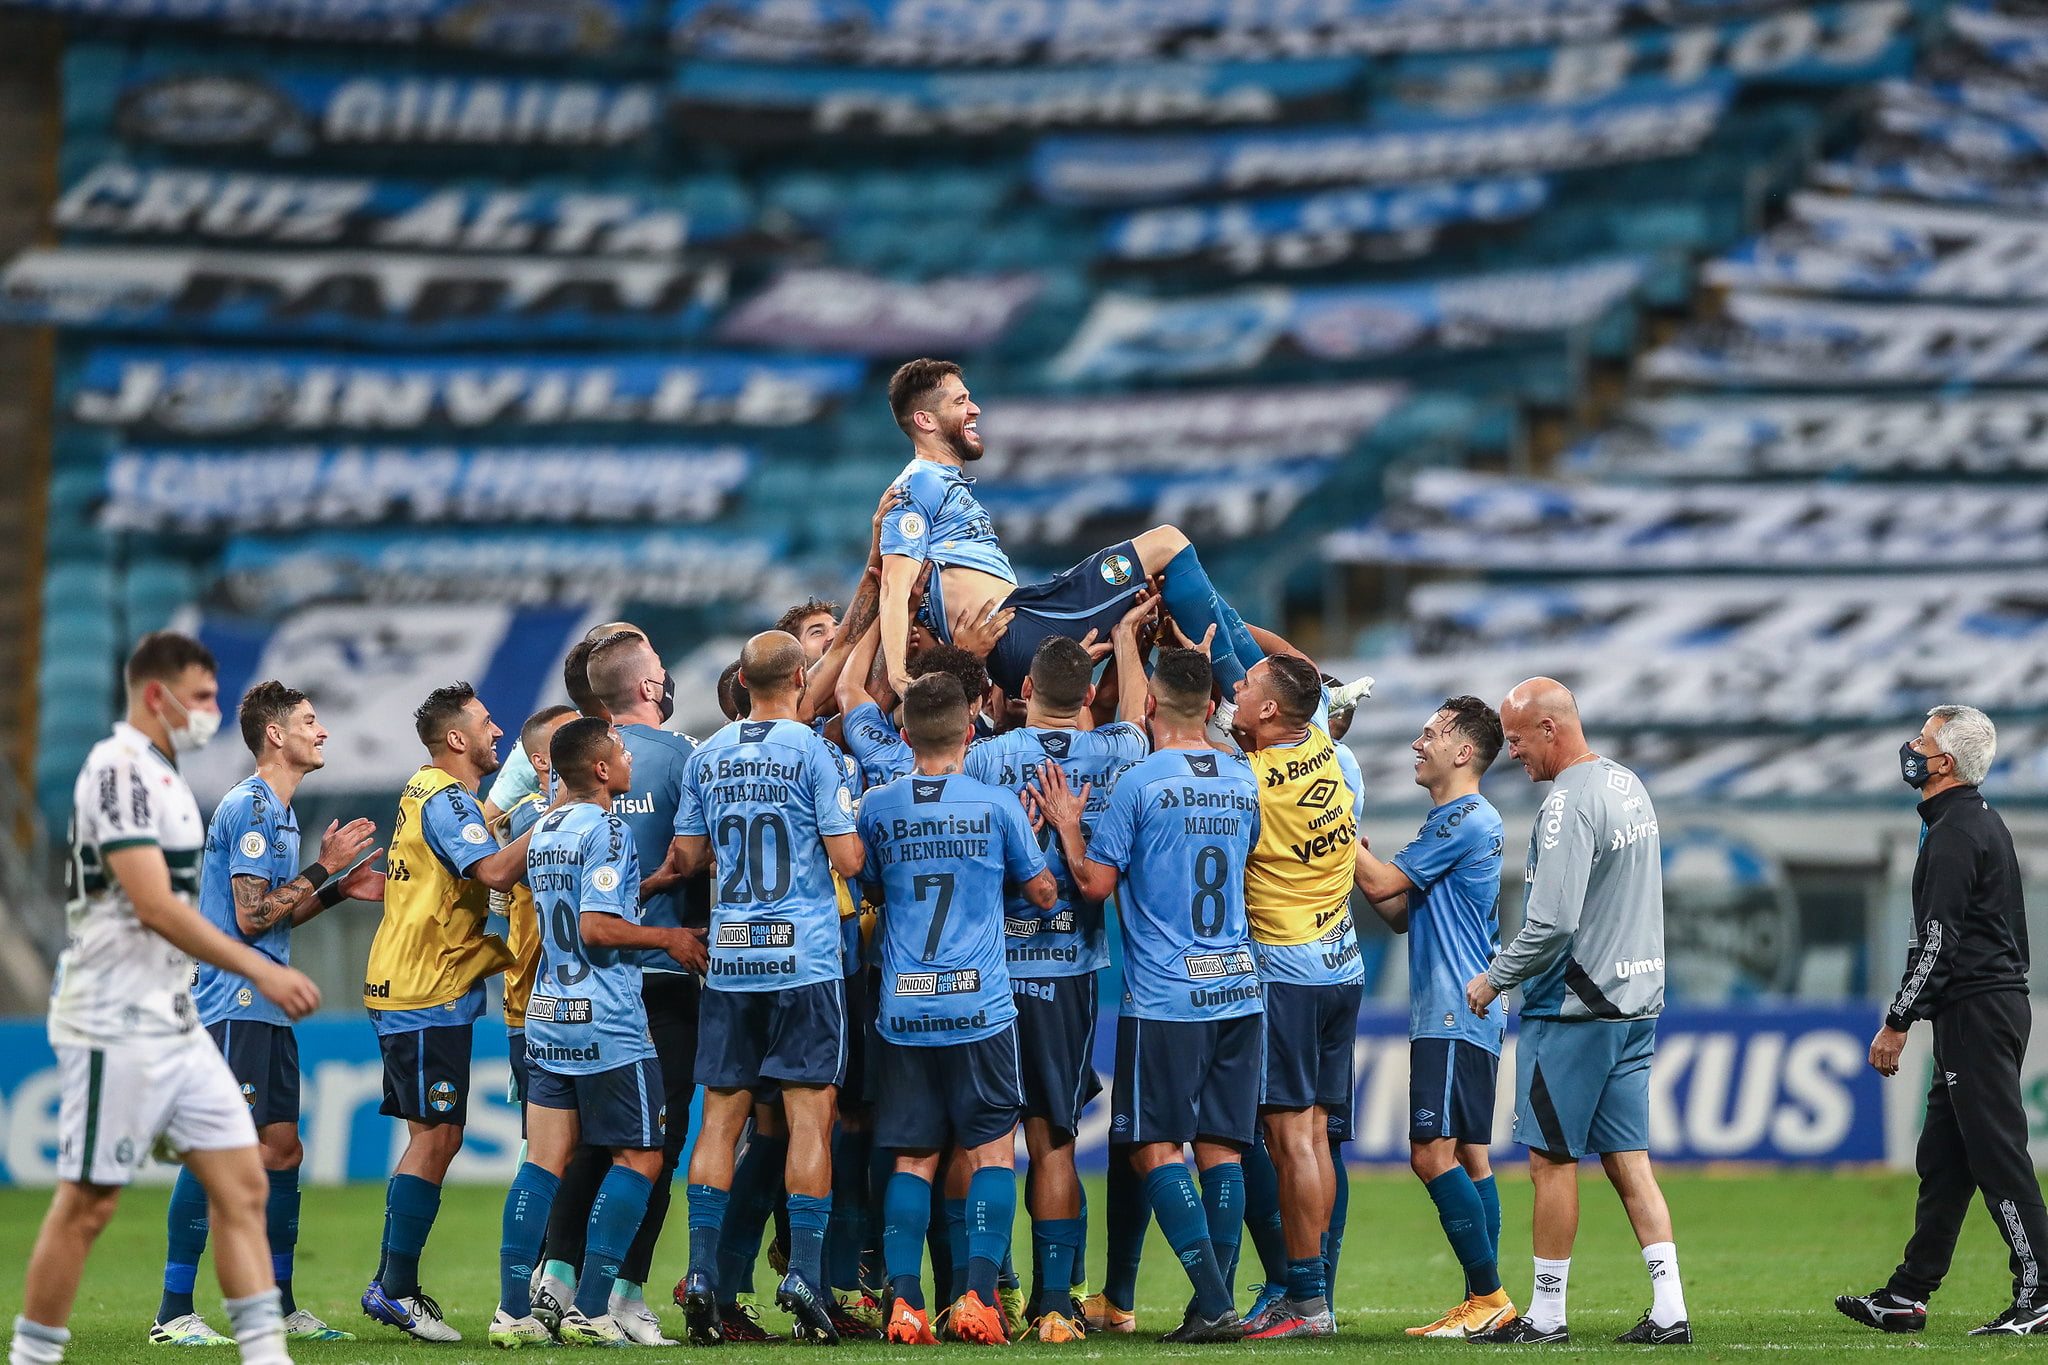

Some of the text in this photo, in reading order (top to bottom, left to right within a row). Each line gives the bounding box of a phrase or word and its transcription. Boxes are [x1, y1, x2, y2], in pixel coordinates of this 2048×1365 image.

[55, 162, 690, 250] CRUZ ALTA
[718, 757, 803, 784] Banrisul
[610, 791, 656, 814] risul
[892, 812, 991, 841] Banrisul
[1184, 816, 1240, 837] MAICON
[1308, 804, 1344, 831] umbro
[900, 839, 989, 862] HENRIQUE
[1290, 823, 1350, 864] vero
[528, 843, 585, 870] Banrisul
[718, 812, 792, 904] 20
[1191, 845, 1228, 938] 8
[913, 873, 956, 962] 7
[771, 935, 789, 945] VIER
[777, 924, 793, 935] QUE
[1006, 943, 1078, 963] nimed
[711, 955, 796, 976] Unimed
[1191, 960, 1221, 974] UNIDOS
[899, 978, 932, 992] UNIDOS
[956, 972, 962, 981] O
[962, 970, 978, 980] QUE
[937, 980, 976, 993] DER E VIER
[569, 1010, 587, 1021] VIER
[574, 1000, 590, 1011] QUE
[890, 1009, 988, 1034] Unimed
[527, 1042, 601, 1061] Unimed
[1535, 1284, 1561, 1294] umbro
